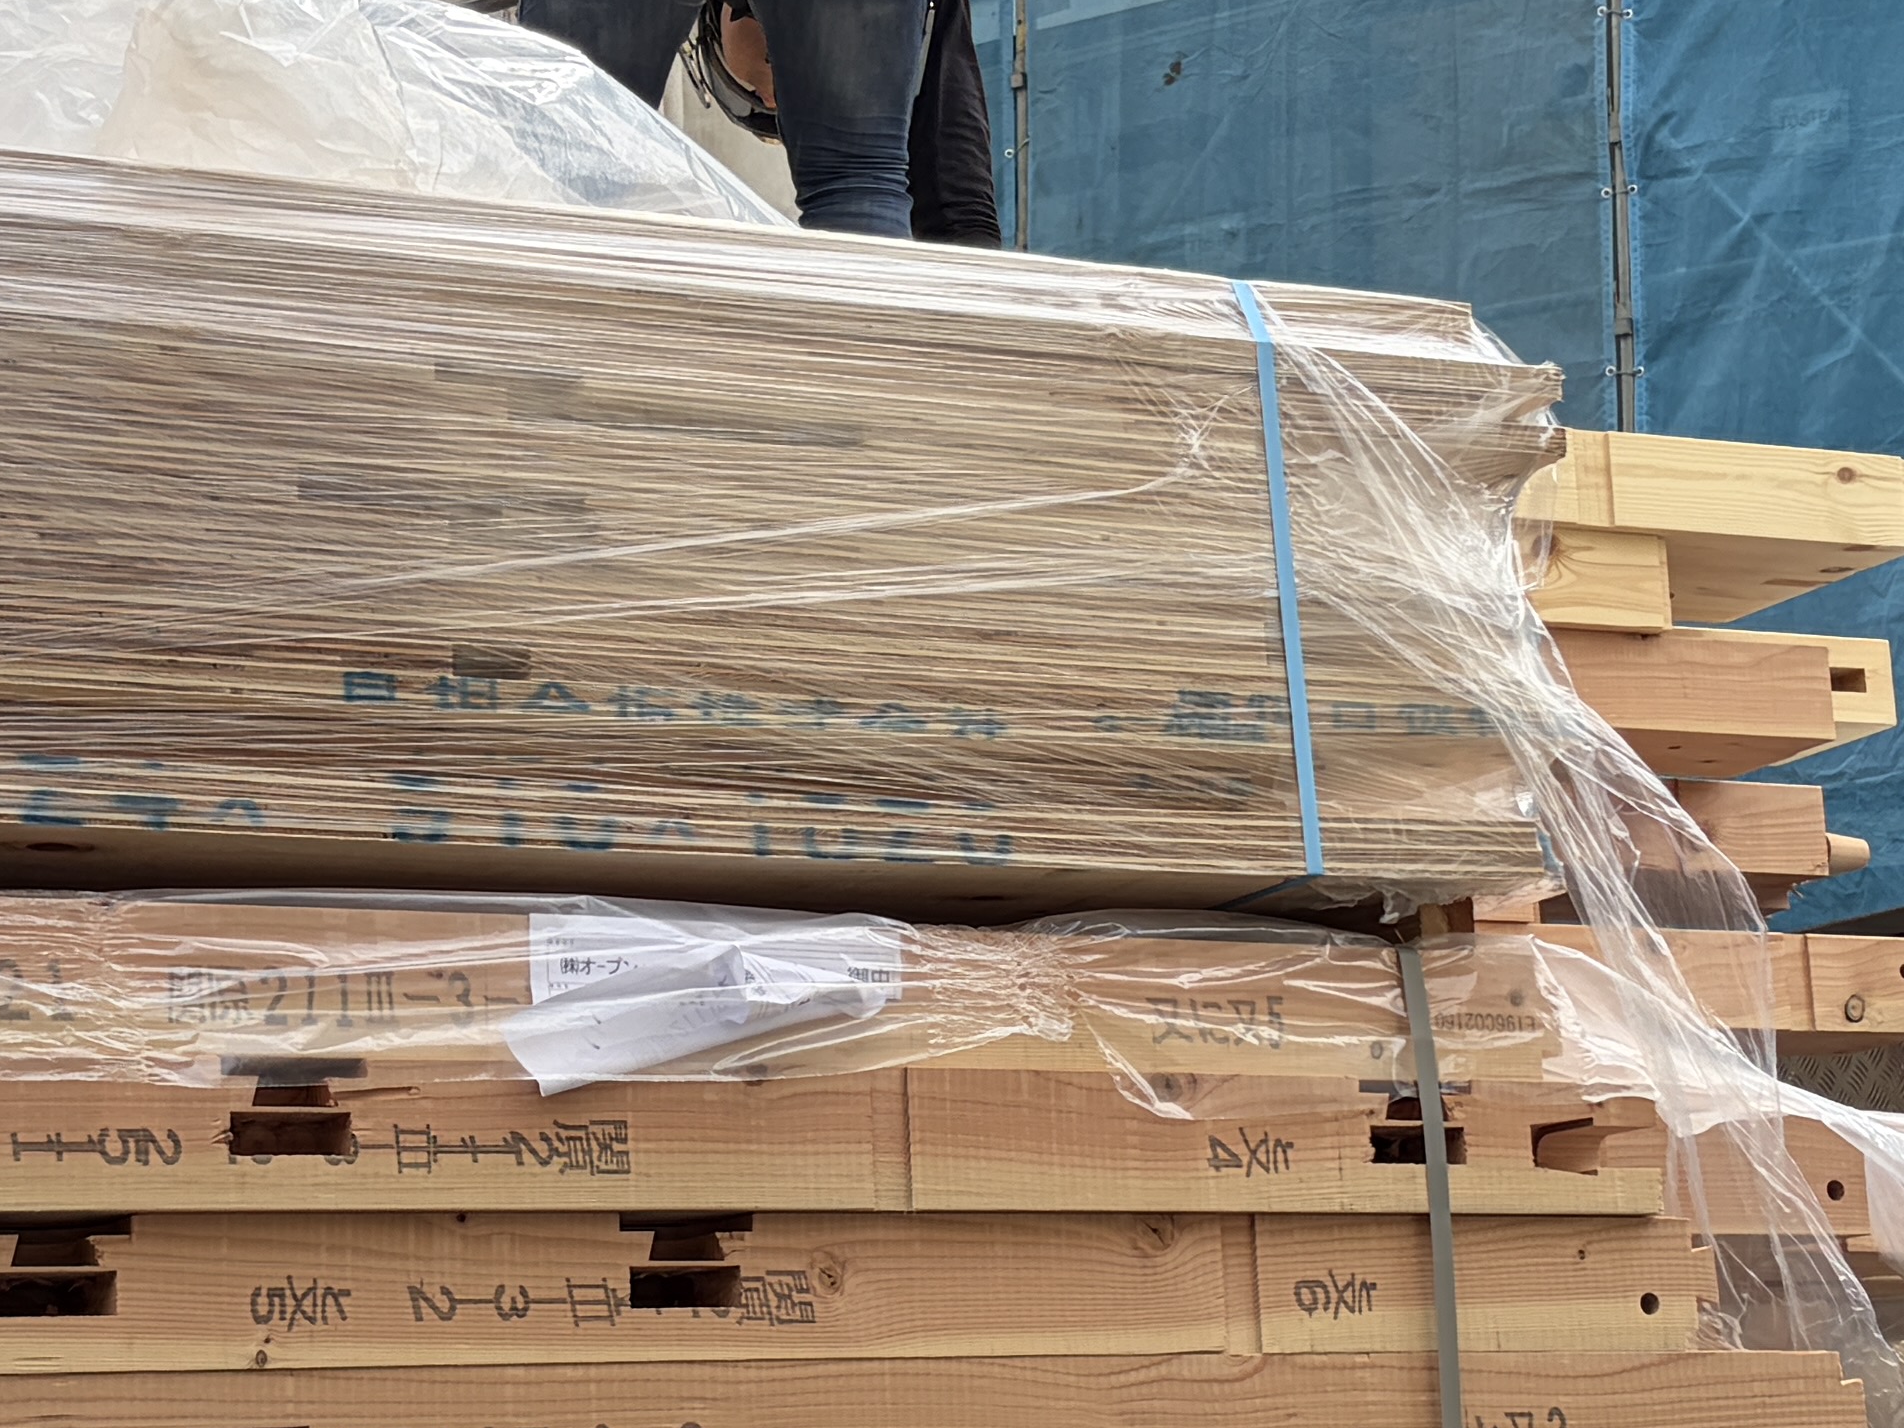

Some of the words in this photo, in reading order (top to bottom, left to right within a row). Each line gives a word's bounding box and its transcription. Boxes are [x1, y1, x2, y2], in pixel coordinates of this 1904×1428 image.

[1207, 1127, 1294, 1178] と又4
[251, 1277, 350, 1331] と又5
[1294, 1269, 1377, 1320] と又6
